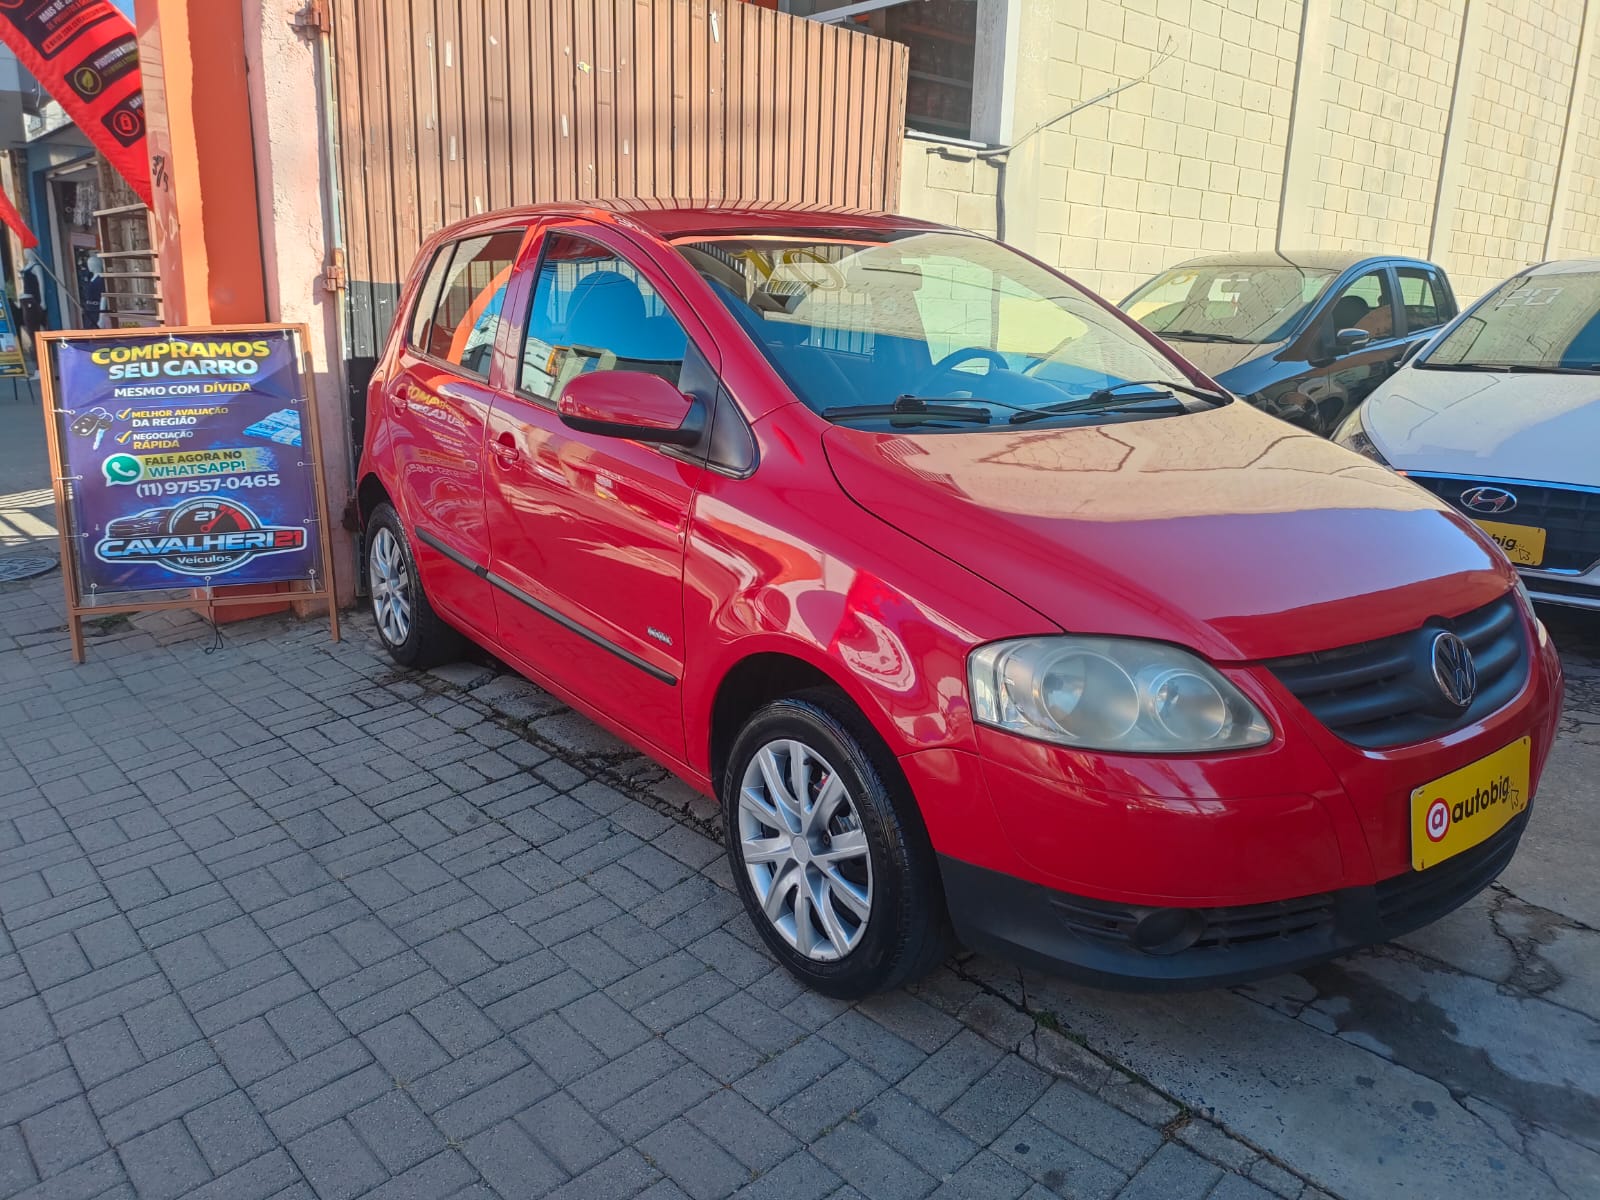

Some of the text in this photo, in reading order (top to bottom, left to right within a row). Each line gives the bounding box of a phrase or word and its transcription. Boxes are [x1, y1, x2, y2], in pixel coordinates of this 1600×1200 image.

[38, 3, 57, 23] MAIS
[91, 341, 270, 365] COMPRAMOS
[109, 359, 258, 380] SEU CARRO
[114, 382, 252, 397] MESMO COM DÍVIDA
[132, 407, 229, 418] MELHOR AVALIAÇÃO
[132, 415, 197, 427] DA REGIÃO
[133, 431, 194, 440] NEGOCIAÇÃO
[133, 439, 180, 450] RÁPIDA
[145, 450, 242, 465] FALE AGORA NO
[149, 461, 246, 477] WHATSAPP!
[136, 474, 280, 497] (11) 97557-0465
[194, 511, 217, 521] 21
[1451, 775, 1510, 823] autobig
